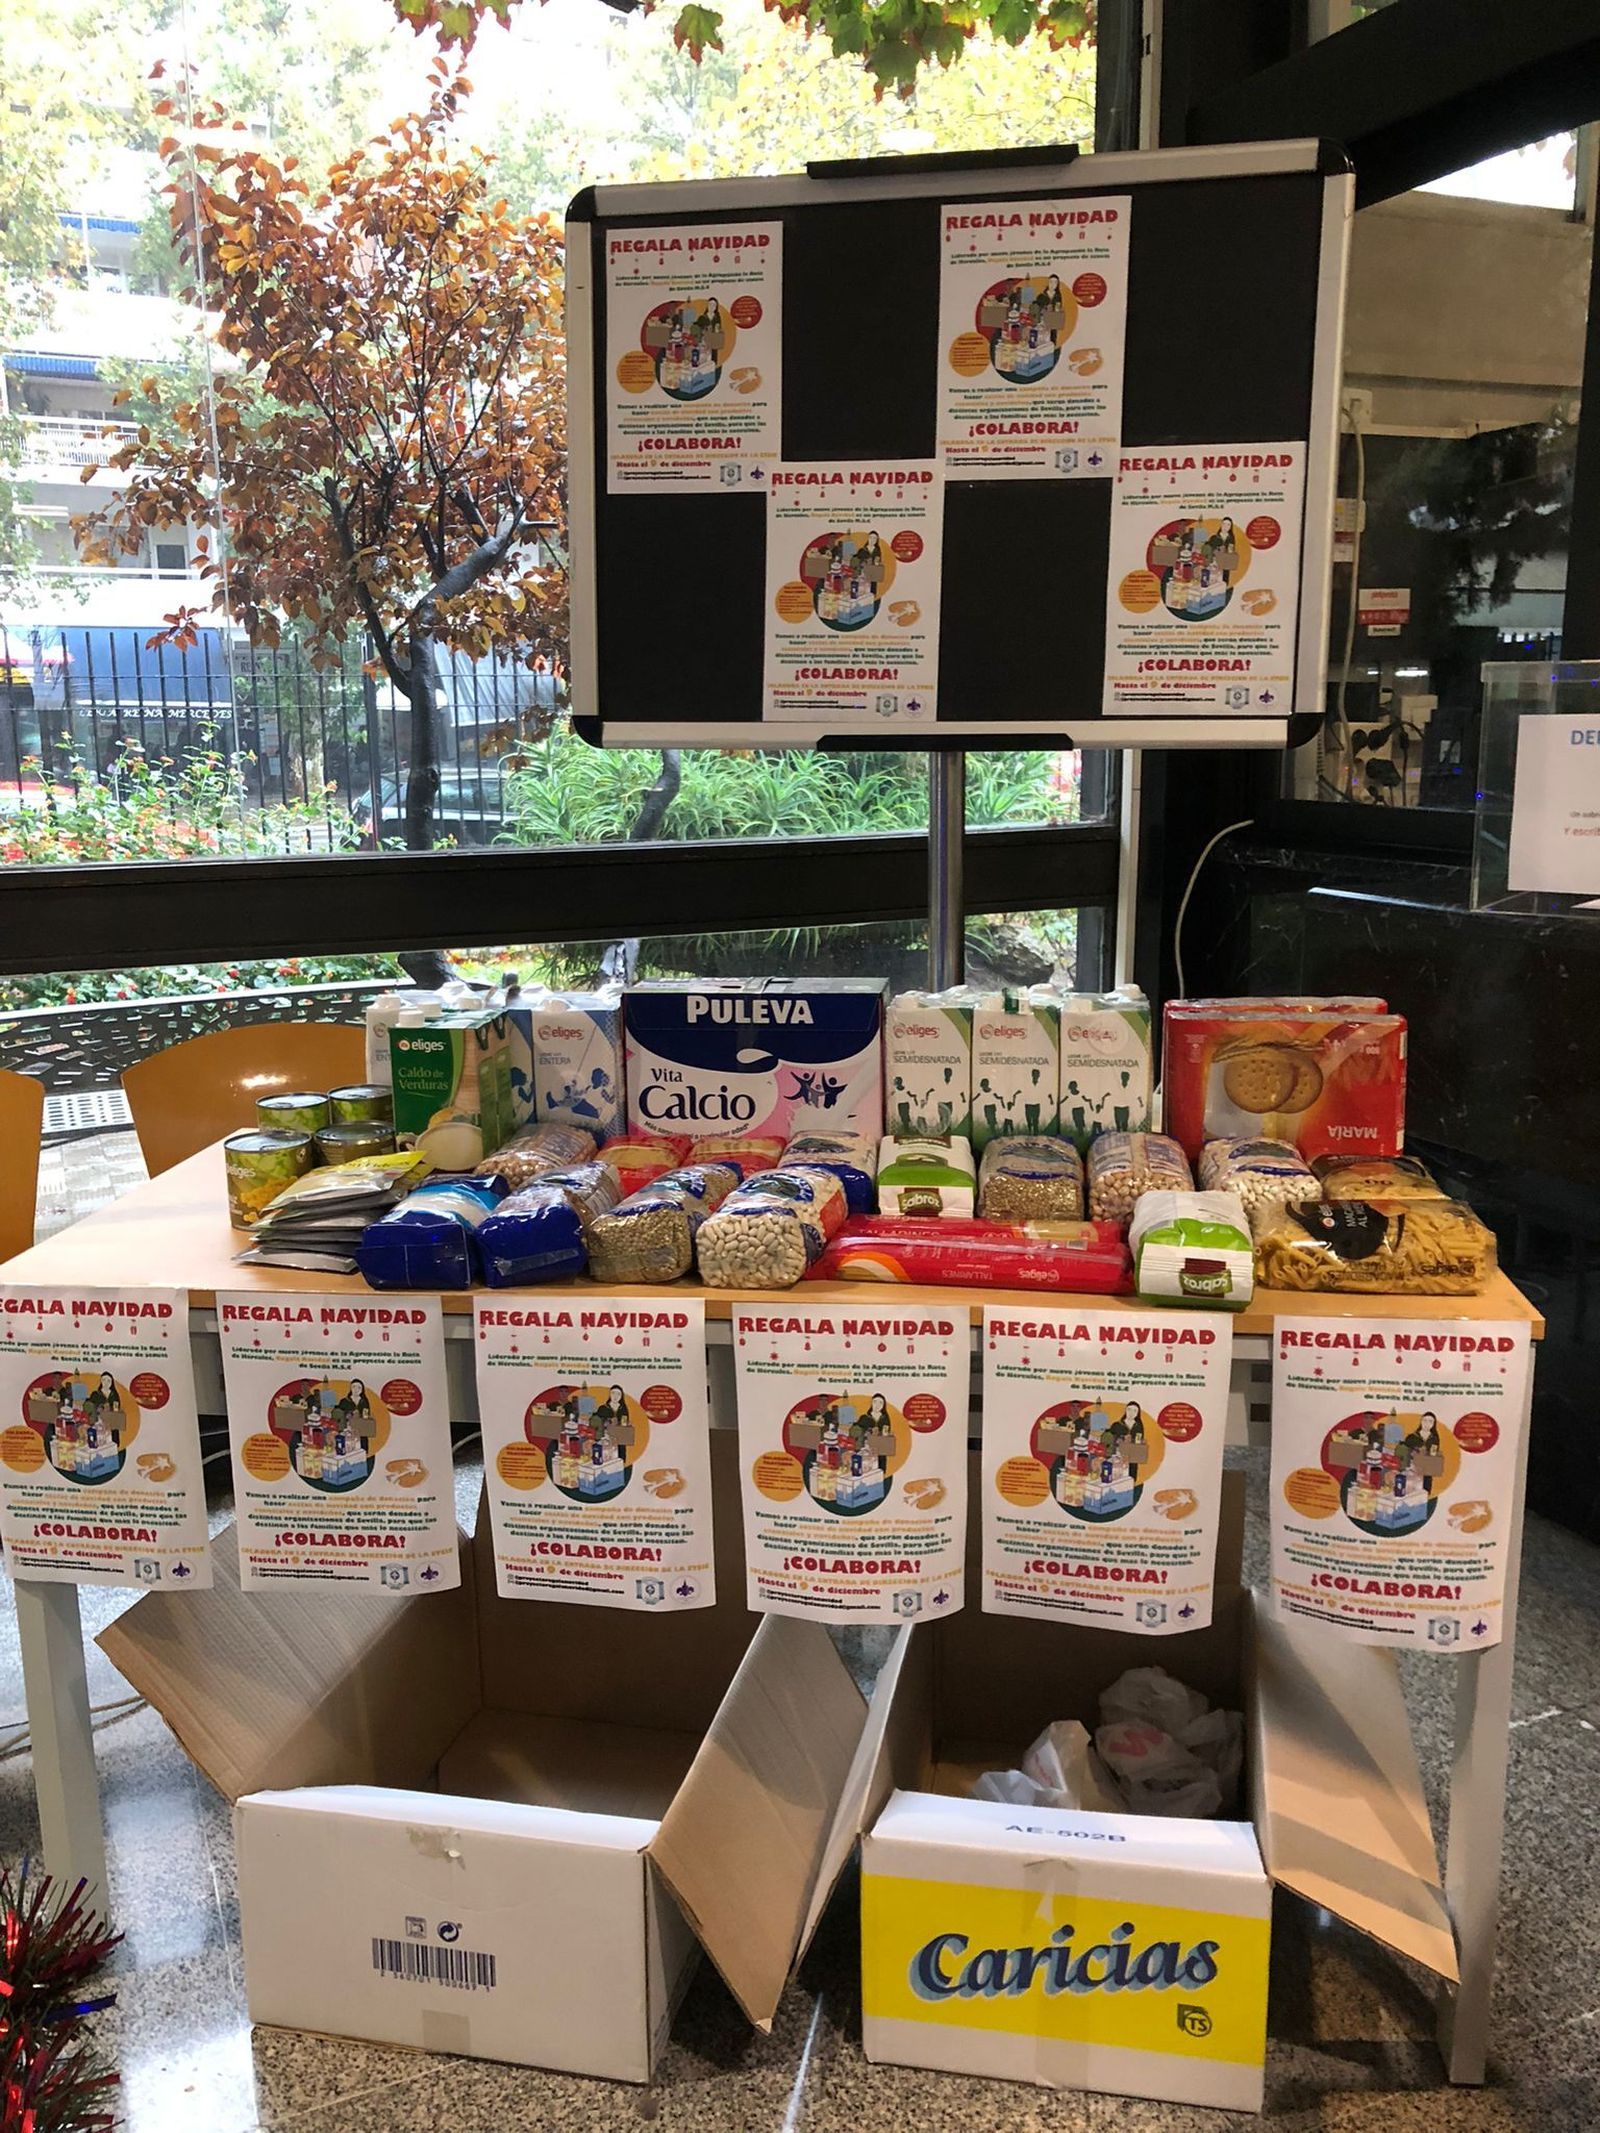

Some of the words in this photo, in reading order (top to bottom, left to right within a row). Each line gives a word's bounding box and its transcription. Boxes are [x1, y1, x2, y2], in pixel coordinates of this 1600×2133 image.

[946, 212, 1022, 230] REGALA
[1029, 209, 1118, 227] NAVIDAD
[610, 239, 683, 254] REGALA
[688, 234, 770, 251] NAVIDAD
[969, 421, 1079, 438] ¡COLABORA!
[638, 437, 742, 452] ¡COLABORA!
[1119, 456, 1196, 472] REGALA
[1202, 454, 1293, 469] NAVIDAD
[771, 472, 844, 486] REGALA
[849, 471, 933, 485] NAVIDAD
[795, 668, 898, 682] ¡COLABORA!
[1138, 659, 1251, 673] ¡COLABORA!
[686, 995, 815, 1025] PULEVA
[551, 1026, 584, 1041] eliges
[993, 1025, 1027, 1040] eliges
[411, 1038, 445, 1053] eliges
[893, 1055, 962, 1065] SEMIDESNATADA
[979, 1056, 1050, 1066] SEMIDESNATADA
[1067, 1058, 1139, 1068] SEMIDESNATADA
[398, 1067, 432, 1079] Caldo
[433, 1069, 444, 1078] de
[650, 1068, 683, 1083] Vita
[398, 1078, 449, 1091] Verduras
[638, 1085, 756, 1121] Calcio
[1328, 1125, 1378, 1139] MARÍA
[71, 1300, 173, 1319] NAVIDAD
[222, 1304, 314, 1323] REGALA
[320, 1307, 427, 1325] NAVIDAD
[480, 1310, 573, 1328] REGALA
[580, 1312, 689, 1329] NAVIDAD
[738, 1317, 835, 1335] REGALA
[842, 1319, 954, 1336] NAVIDAD
[989, 1320, 1091, 1341] REGALA
[1099, 1325, 1216, 1345] NAVIDAD
[1280, 1330, 1386, 1351] REGALA
[1394, 1333, 1514, 1353] NAVIDAD
[33, 1523, 157, 1543] ¡COLABORA!
[274, 1532, 406, 1549] ¡COLABORA!
[530, 1541, 662, 1562] ¡COLABORA!
[505, 1564, 533, 1574] Hasta
[535, 1565, 545, 1574] el
[559, 1568, 572, 1577] de
[574, 1569, 625, 1580] diciembre
[783, 1556, 921, 1574] ¡COLABORA!
[1024, 1560, 1168, 1584] ¡COLABORA!
[757, 1577, 785, 1588] Hasta
[788, 1580, 797, 1590] el
[812, 1585, 825, 1593] de
[827, 1585, 881, 1595] diciembre
[994, 1579, 1025, 1591] Hasta
[1028, 1582, 1037, 1592] el
[1053, 1586, 1067, 1596] de
[1069, 1588, 1125, 1602] diciembre
[1311, 1573, 1463, 1600] ¡COLABORA!
[1005, 1823, 1127, 1843] AE-502B
[909, 1920, 1221, 2003] Caricias
